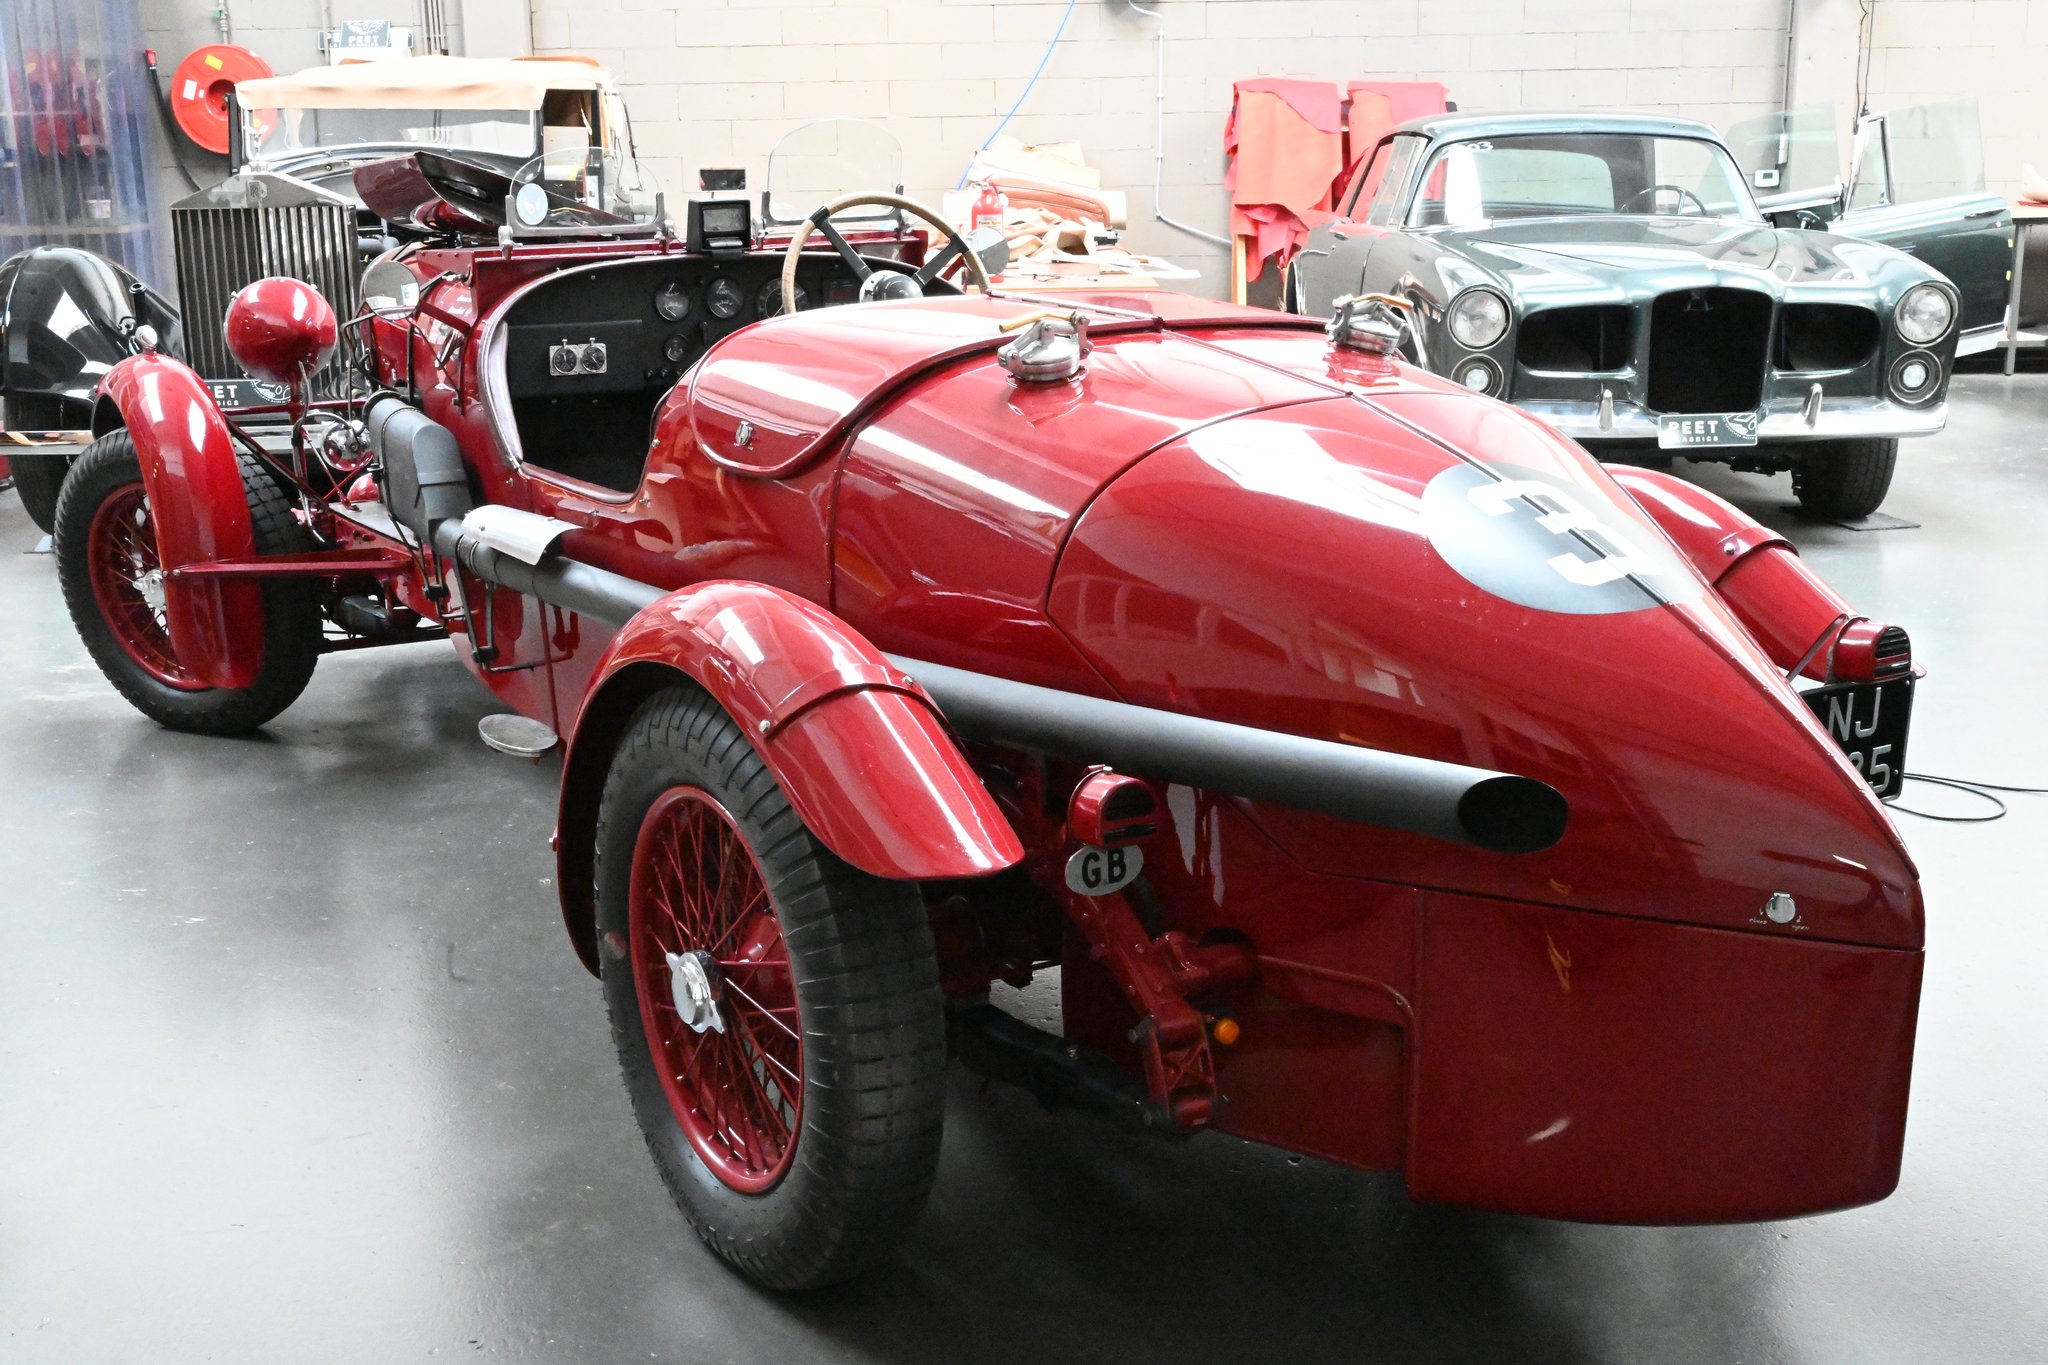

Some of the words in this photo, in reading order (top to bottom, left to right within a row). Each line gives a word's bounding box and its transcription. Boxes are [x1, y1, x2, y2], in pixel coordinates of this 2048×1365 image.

[207, 384, 238, 399] ET
[1668, 420, 1719, 435] PEET
[1681, 435, 1719, 443] ASSICS
[1467, 480, 1662, 586] 3
[1828, 686, 1882, 742] NJ
[1082, 848, 1127, 889] GB
